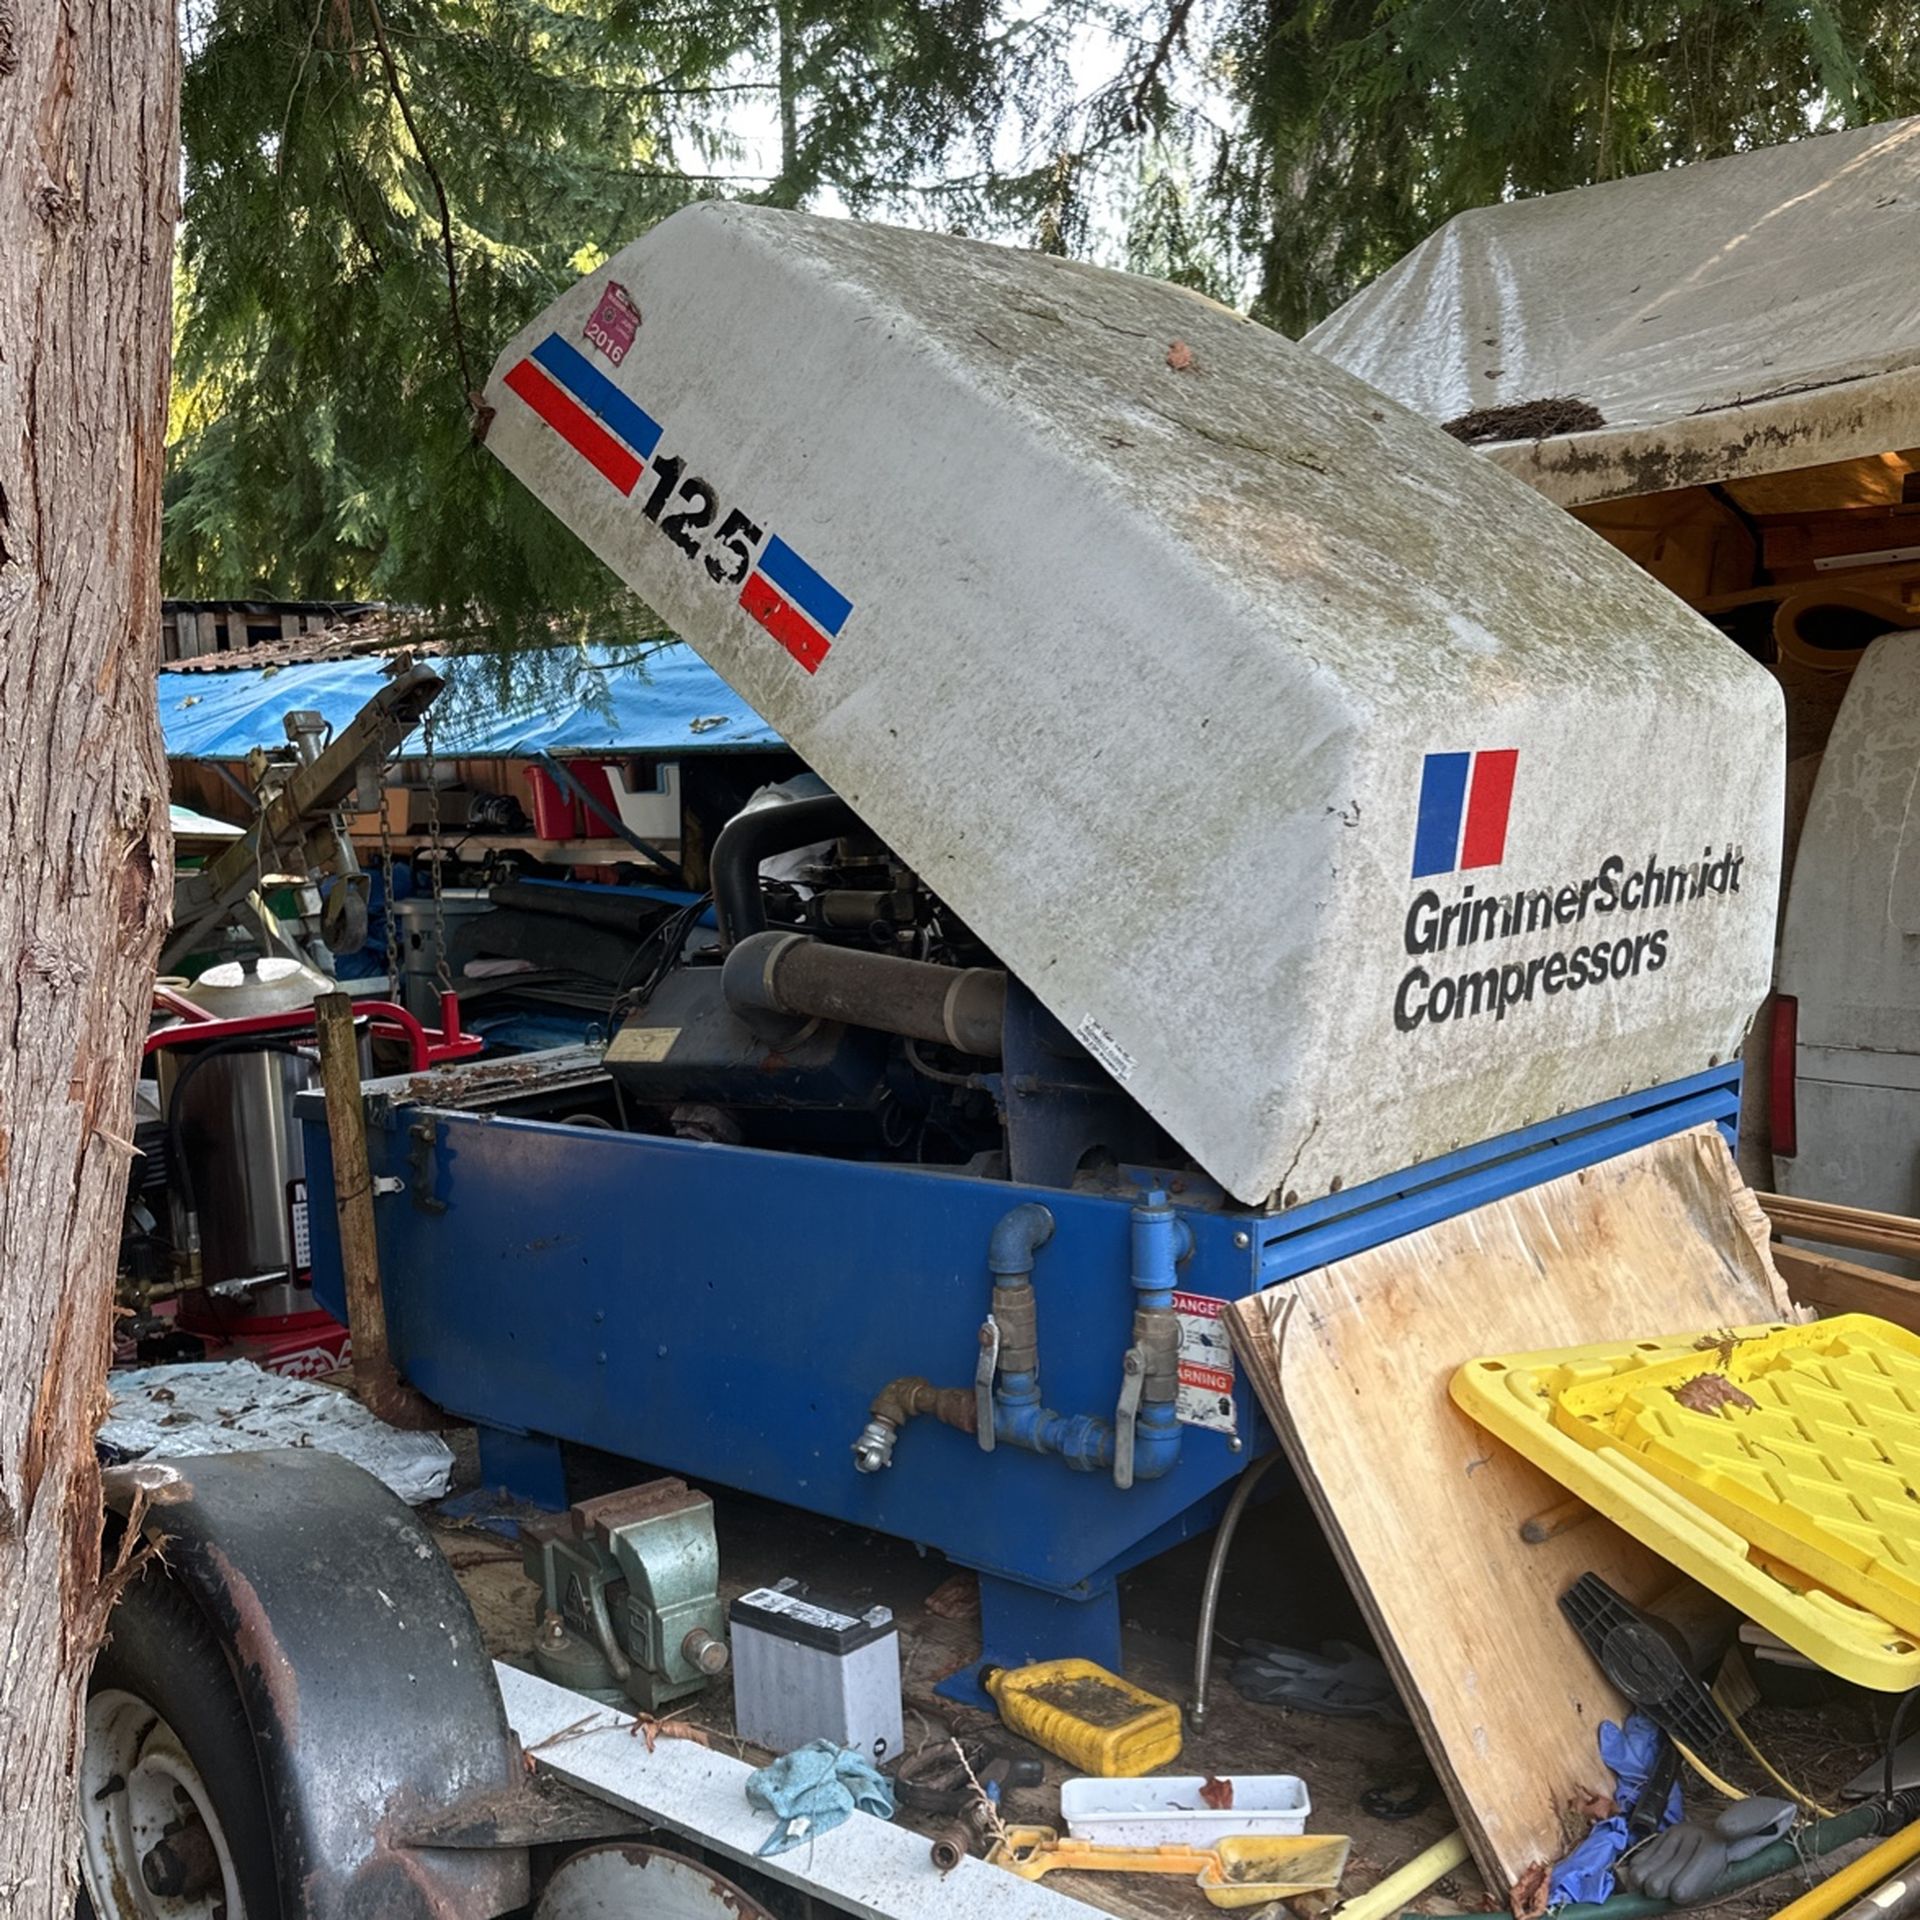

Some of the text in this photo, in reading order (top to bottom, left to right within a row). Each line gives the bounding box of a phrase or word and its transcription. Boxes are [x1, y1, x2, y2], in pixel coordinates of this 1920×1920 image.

[586, 323, 624, 362] 2016
[642, 454, 763, 585] 125
[1403, 842, 1745, 956] GrimmerSchmidt
[1393, 928, 1669, 1033] Compressors
[1177, 1366, 1227, 1390] ARNING
